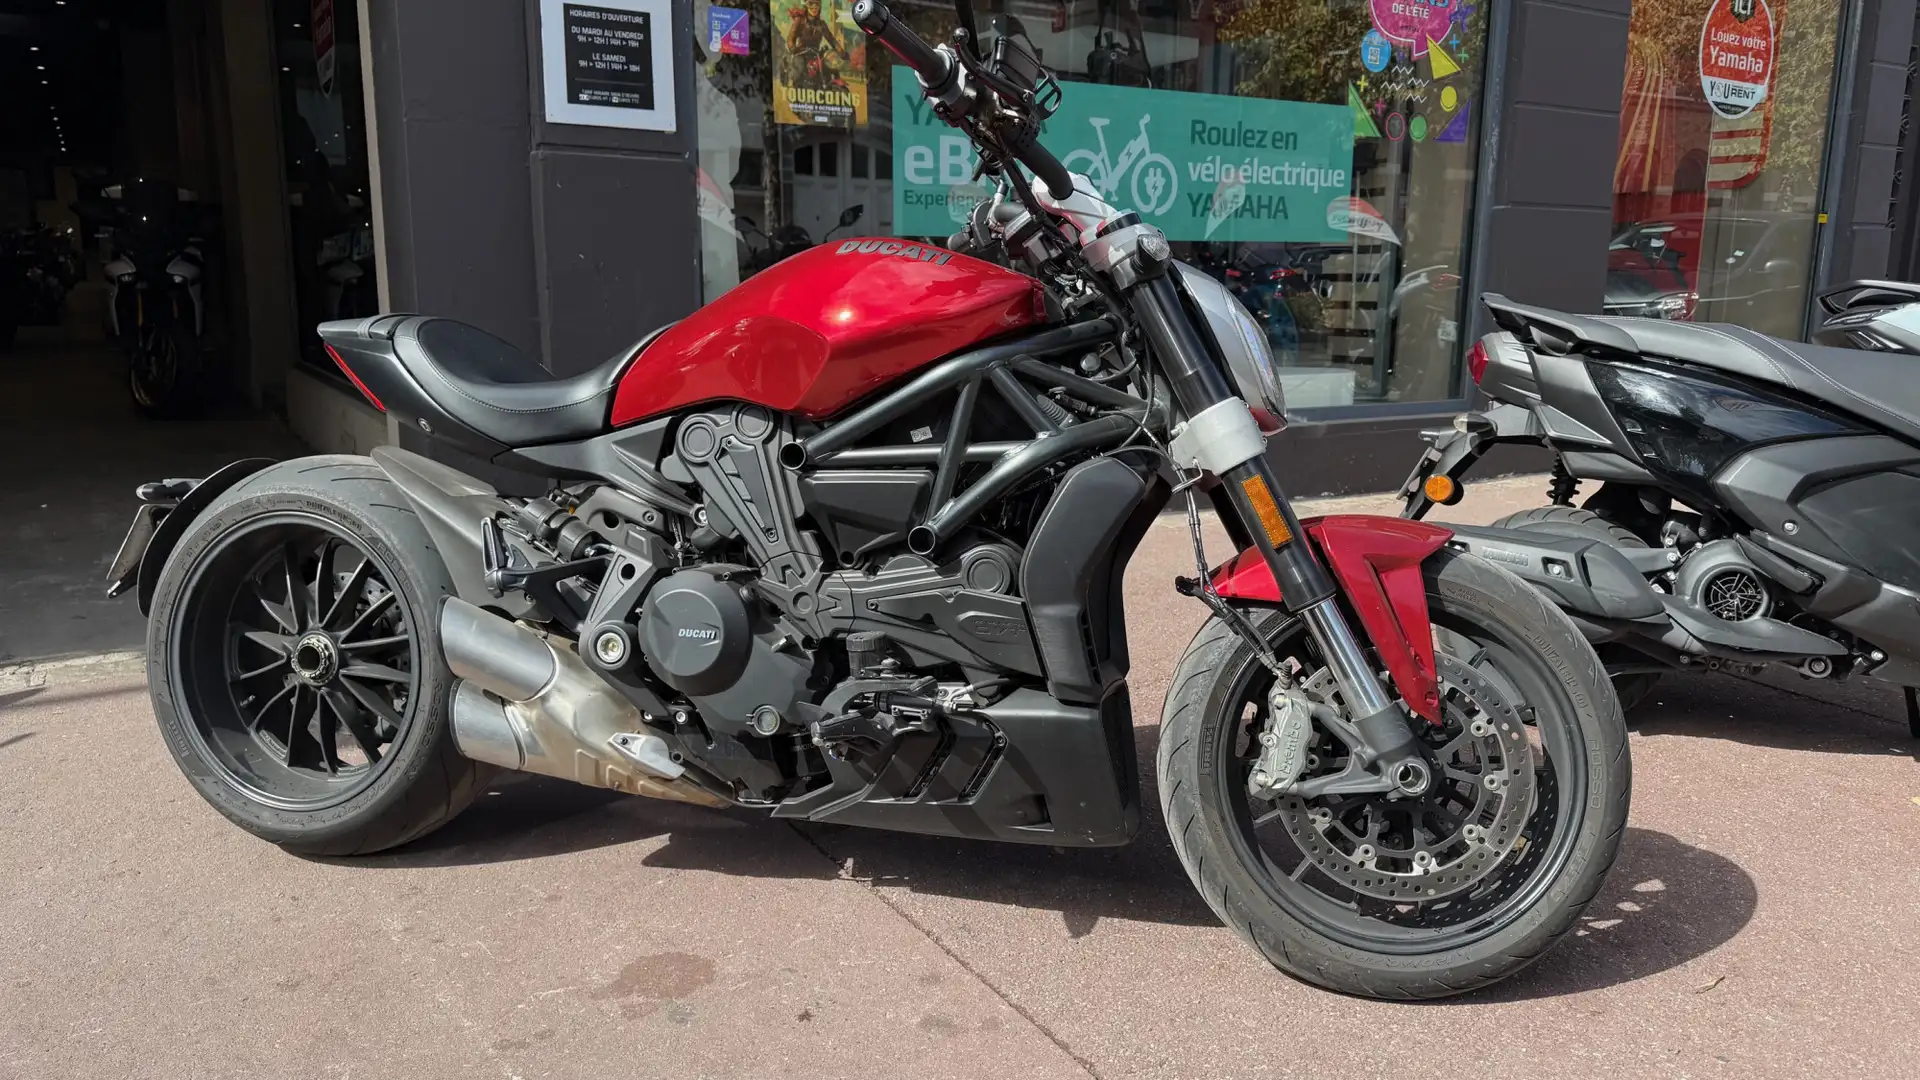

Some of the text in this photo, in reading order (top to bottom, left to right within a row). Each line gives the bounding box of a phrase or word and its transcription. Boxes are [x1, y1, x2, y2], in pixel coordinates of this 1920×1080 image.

[570, 9, 644, 24] HORAIRES D'OUVERTURE
[1392, 3, 1405, 15] DE
[1406, 4, 1430, 19] L'ÉTÉ
[582, 27, 602, 35] MARDI
[604, 29, 613, 37] AU
[614, 30, 644, 40] VENDREDI
[1711, 27, 1767, 50] Louez votre
[602, 54, 626, 62] SAMEDI
[1710, 45, 1763, 73] Yamaha
[780, 86, 861, 106] TOURCOING
[1190, 119, 1298, 151] Roulez en
[1187, 155, 1345, 194] vélo électrique
[904, 189, 988, 210] Experien
[835, 240, 953, 266] DUCATI
[678, 628, 717, 640] DUCATI
[1277, 719, 1302, 774] brembo
[1588, 739, 1603, 809] ROSSO
